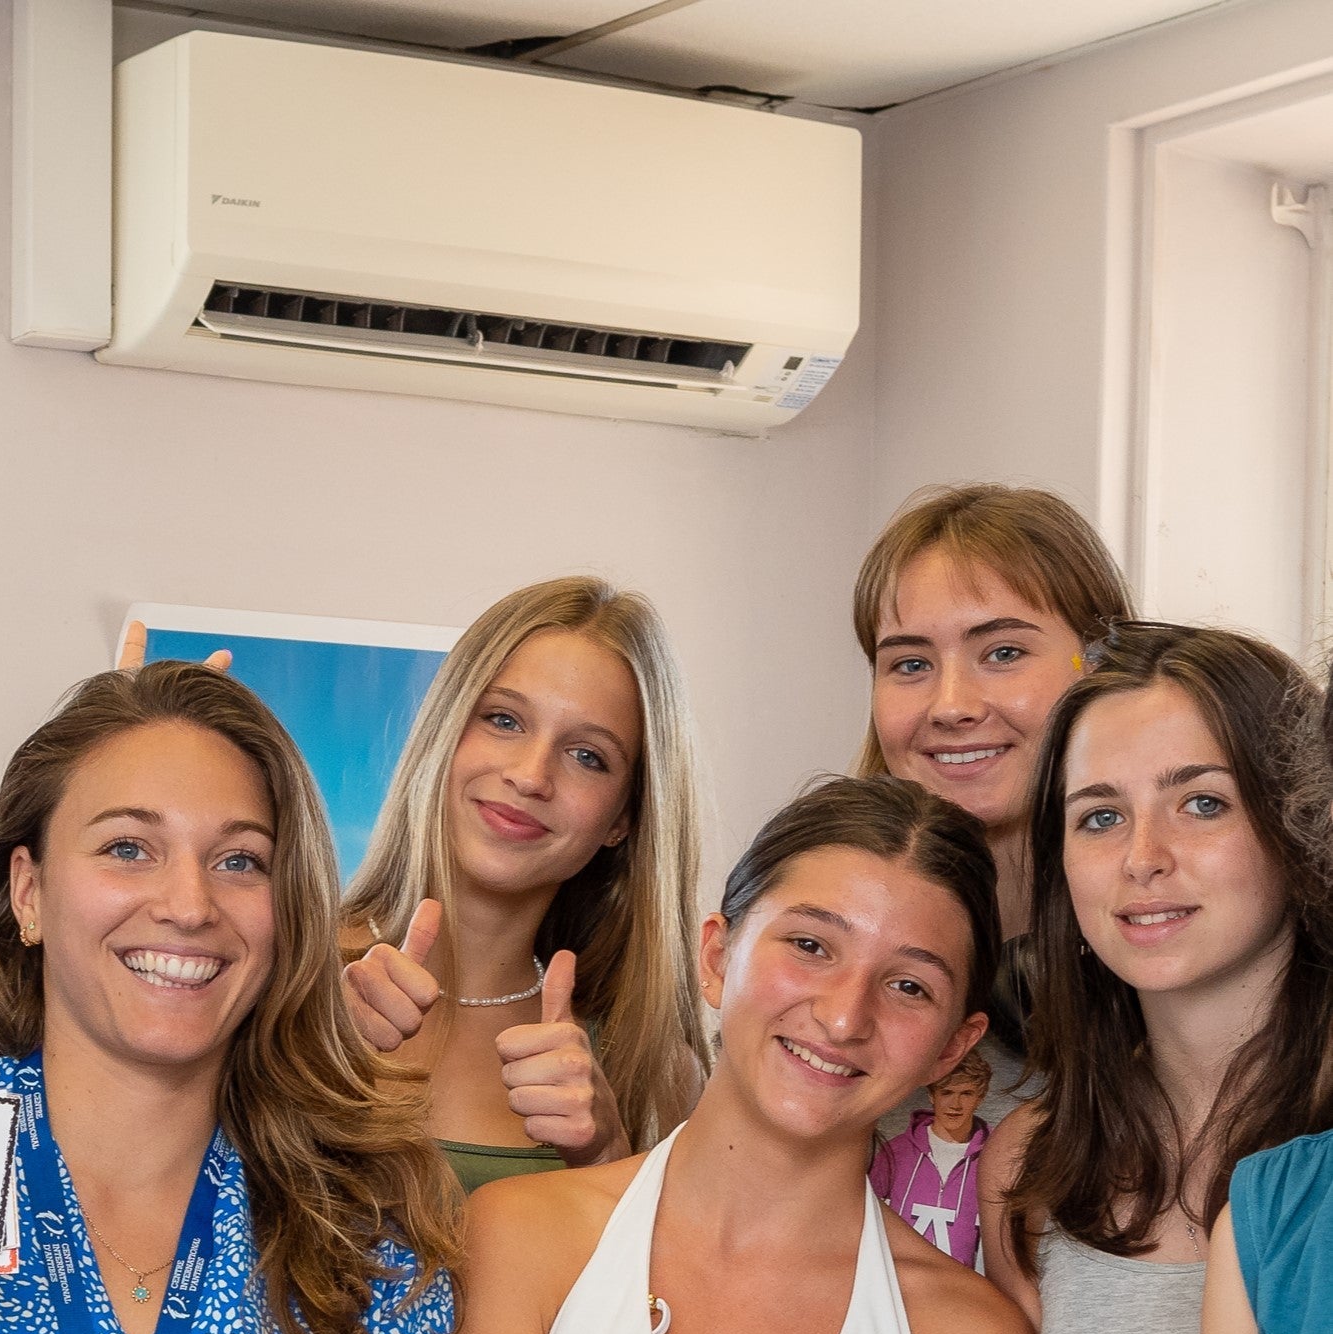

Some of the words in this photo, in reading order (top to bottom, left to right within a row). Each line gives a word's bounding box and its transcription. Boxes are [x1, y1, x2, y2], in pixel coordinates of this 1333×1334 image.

[222, 197, 261, 208] DAIKIN
[25, 1093, 41, 1150] INTERNATIONAL
[33, 1092, 44, 1120] CENTRE
[43, 1244, 58, 1282] D'ANTIBES
[52, 1243, 72, 1304] INTERNATIONAL
[61, 1243, 75, 1274] CENTRE
[170, 1259, 185, 1289] CENTRE
[179, 1237, 201, 1291] INTERNATIONAL
[189, 1256, 205, 1291] D'ANTIBES
